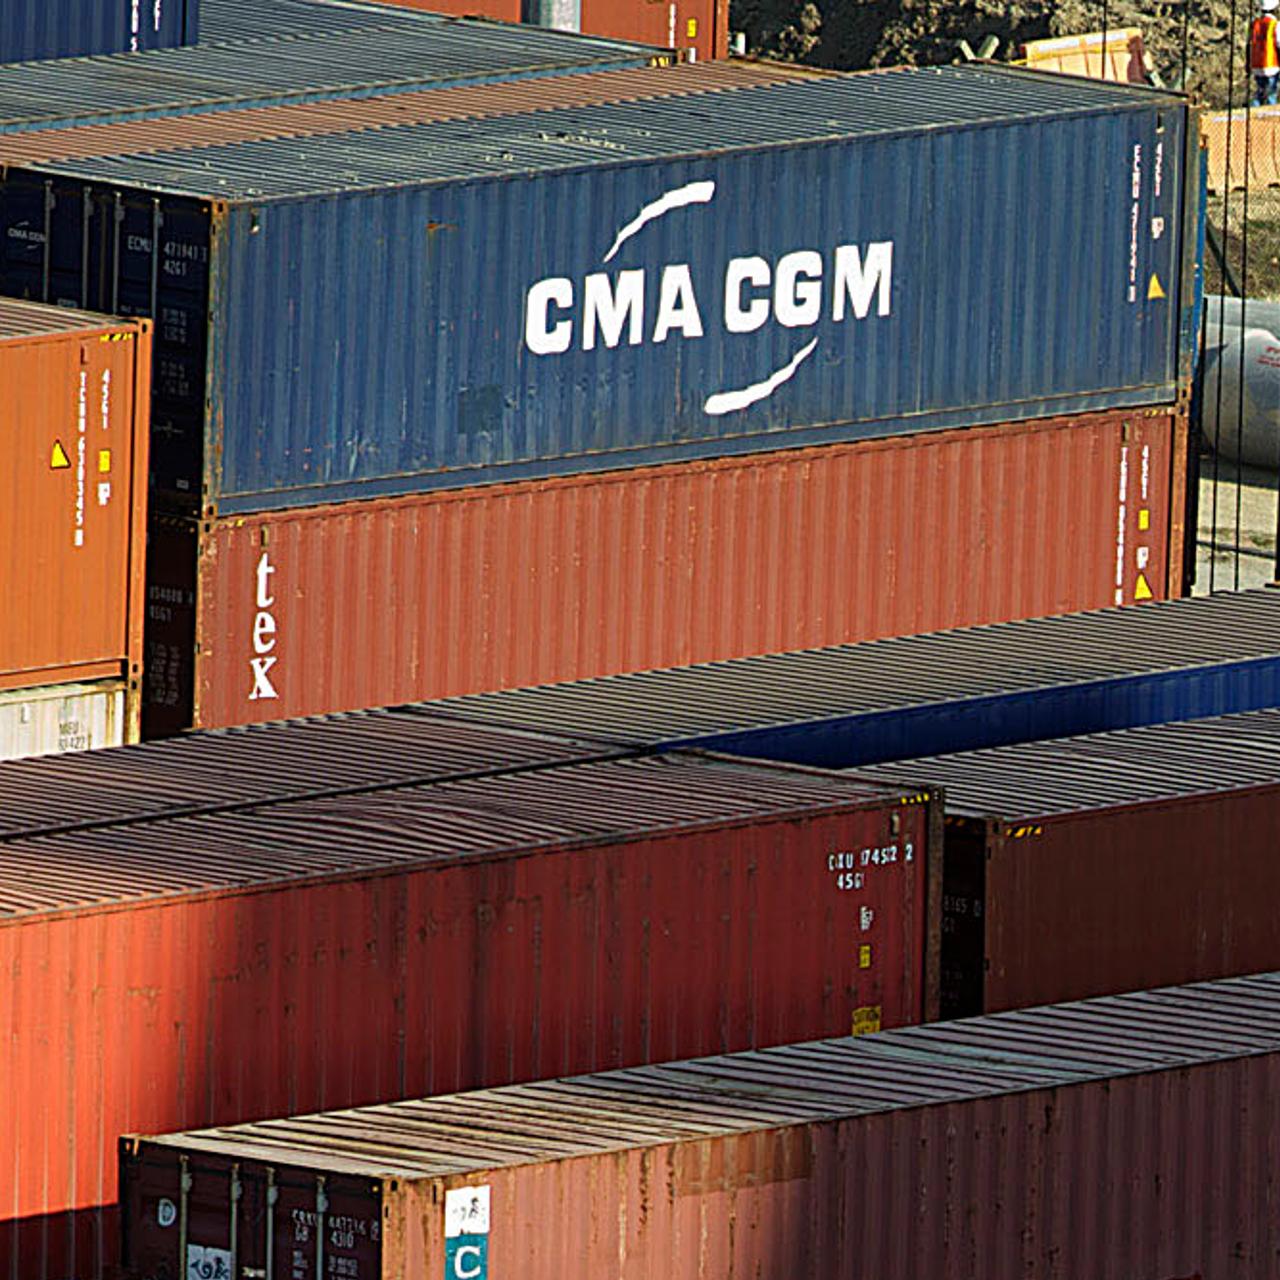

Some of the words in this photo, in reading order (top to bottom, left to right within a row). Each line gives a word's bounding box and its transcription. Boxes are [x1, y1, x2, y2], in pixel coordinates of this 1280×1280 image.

[525, 264, 703, 356] CMA
[725, 241, 893, 333] CGM
[249, 553, 279, 700] tex
